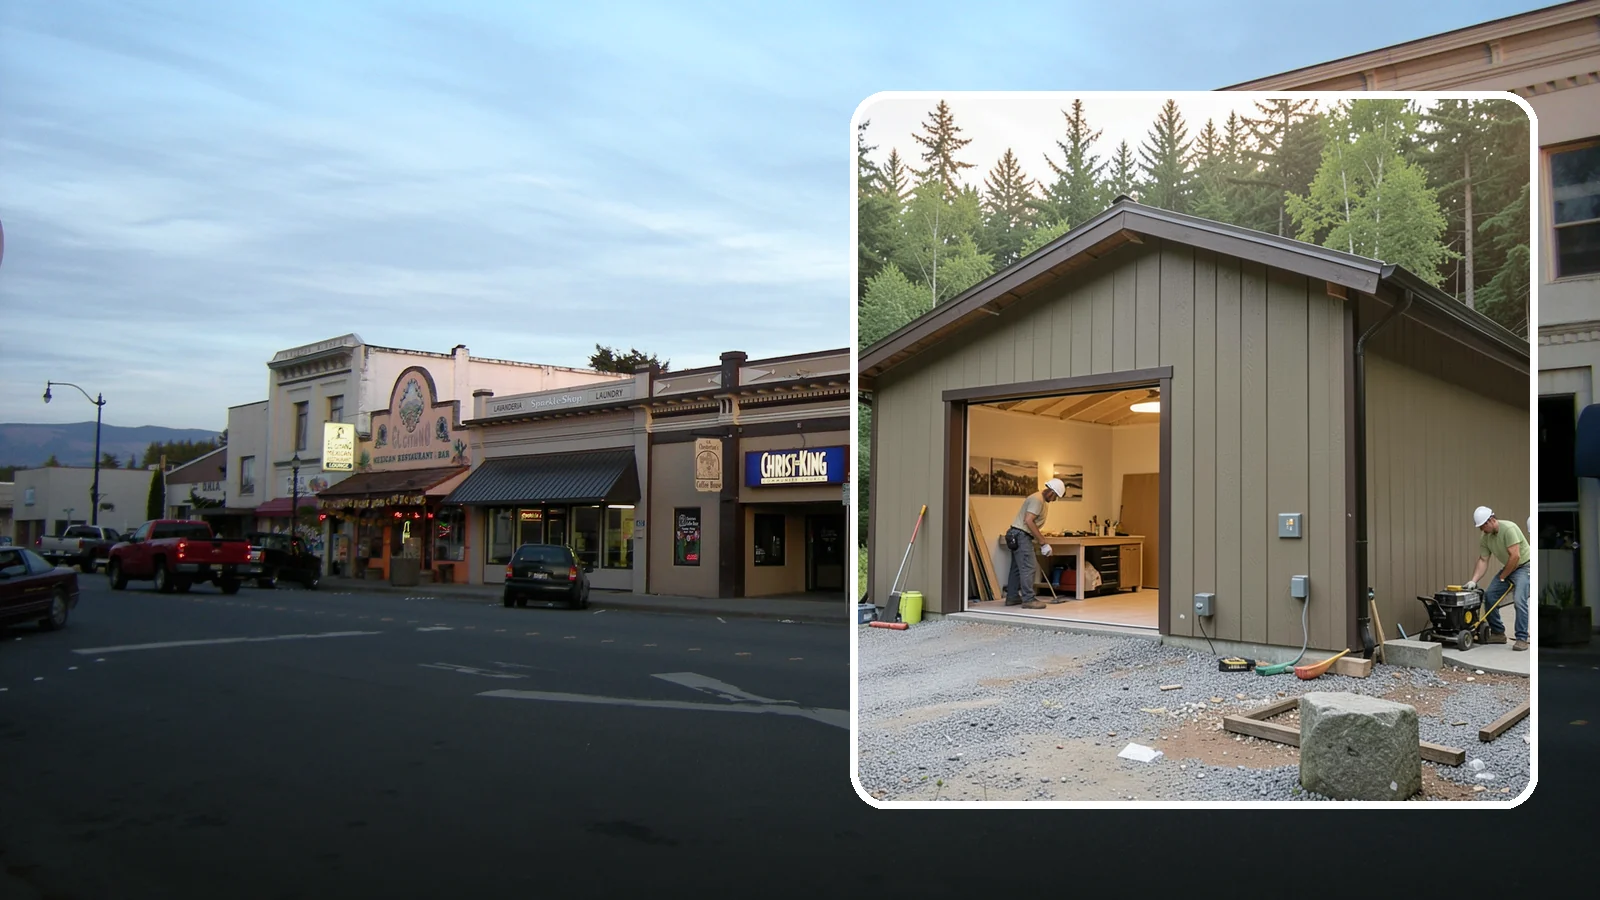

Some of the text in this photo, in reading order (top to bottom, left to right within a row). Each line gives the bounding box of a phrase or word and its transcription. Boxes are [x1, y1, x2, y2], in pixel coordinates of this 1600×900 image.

[560, 394, 582, 406] Shop
[595, 389, 623, 400] LAUNDRY
[493, 402, 522, 412] LAVANDERIA
[374, 454, 396, 464] MEXICAN
[397, 451, 433, 462] RESTAURANT
[438, 450, 450, 459] BAR
[761, 450, 827, 478] CHRIST KING
[697, 480, 709, 489] Coffee
